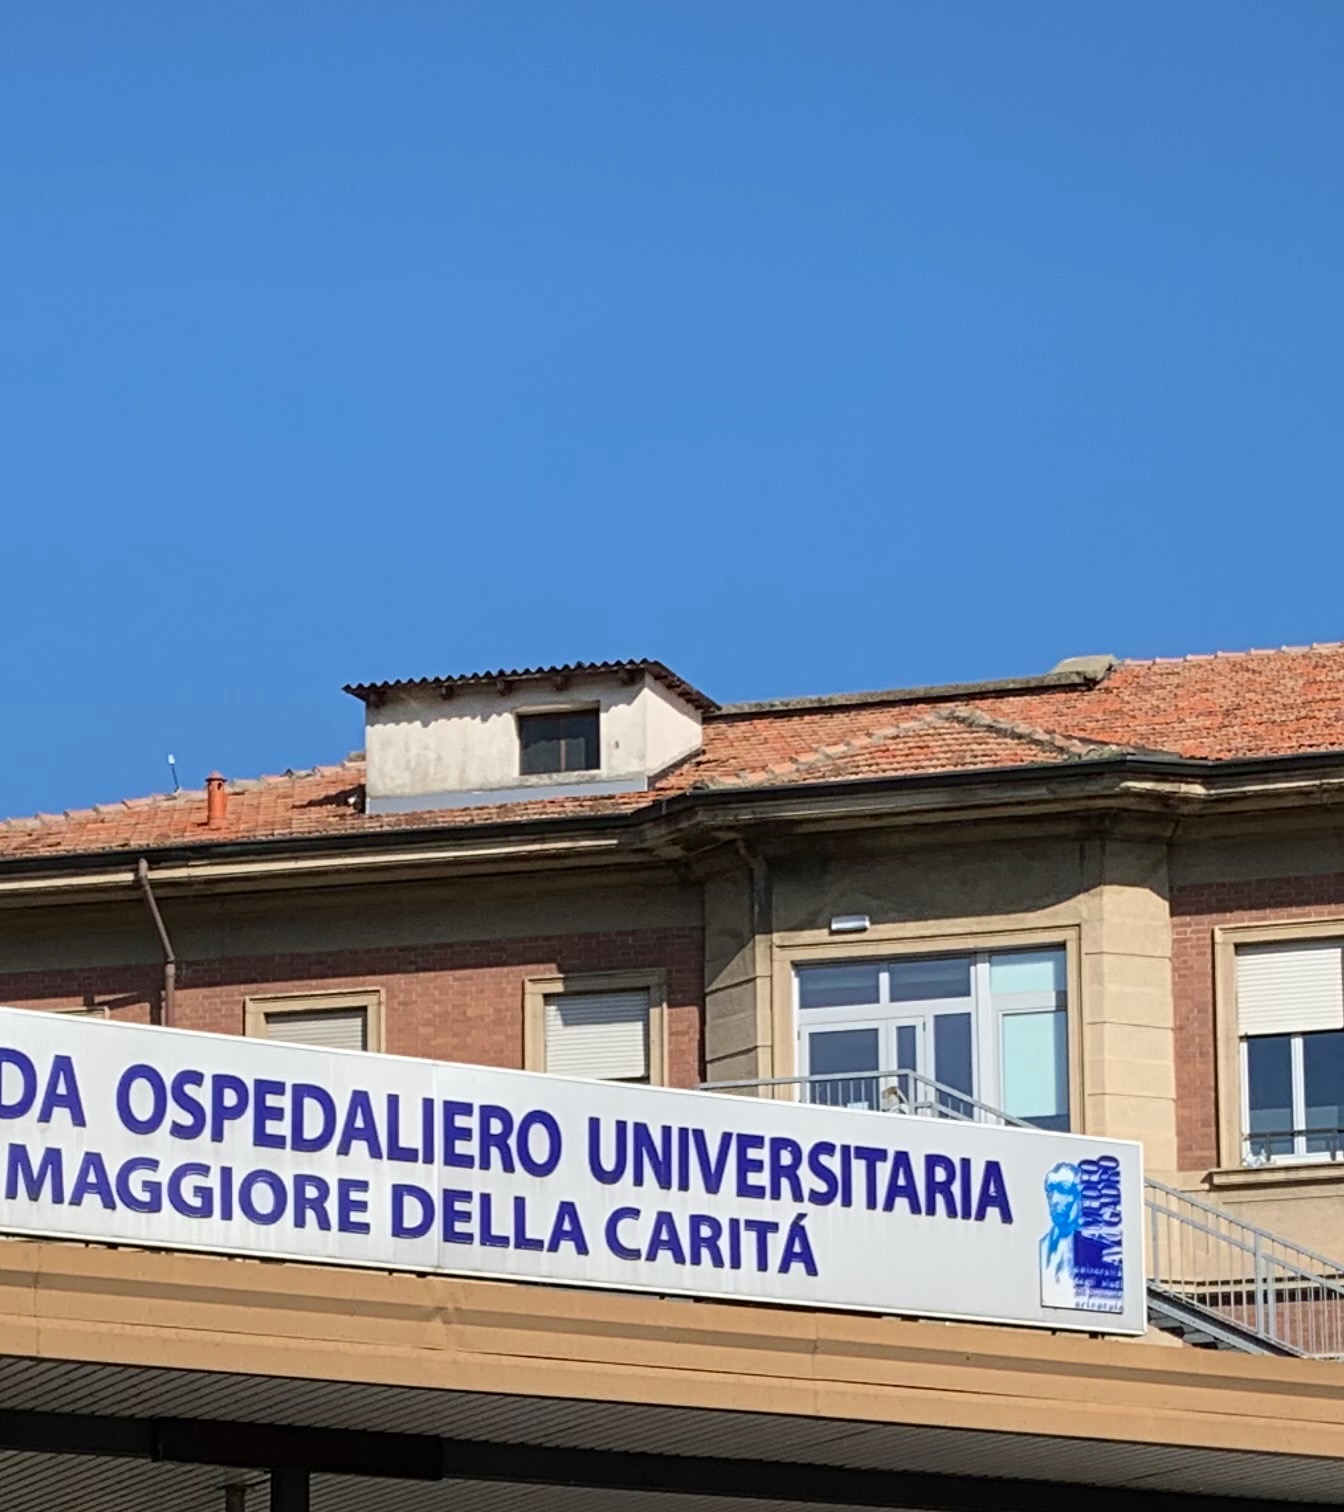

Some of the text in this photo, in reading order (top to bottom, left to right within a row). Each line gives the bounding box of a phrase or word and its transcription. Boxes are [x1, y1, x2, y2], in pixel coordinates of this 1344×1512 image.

[6, 1142, 371, 1235] MAGGIORE
[391, 1183, 589, 1256] DELLA
[115, 1063, 563, 1179] OSPEDALIERO
[588, 1116, 1013, 1225] UNIVERSITARIA
